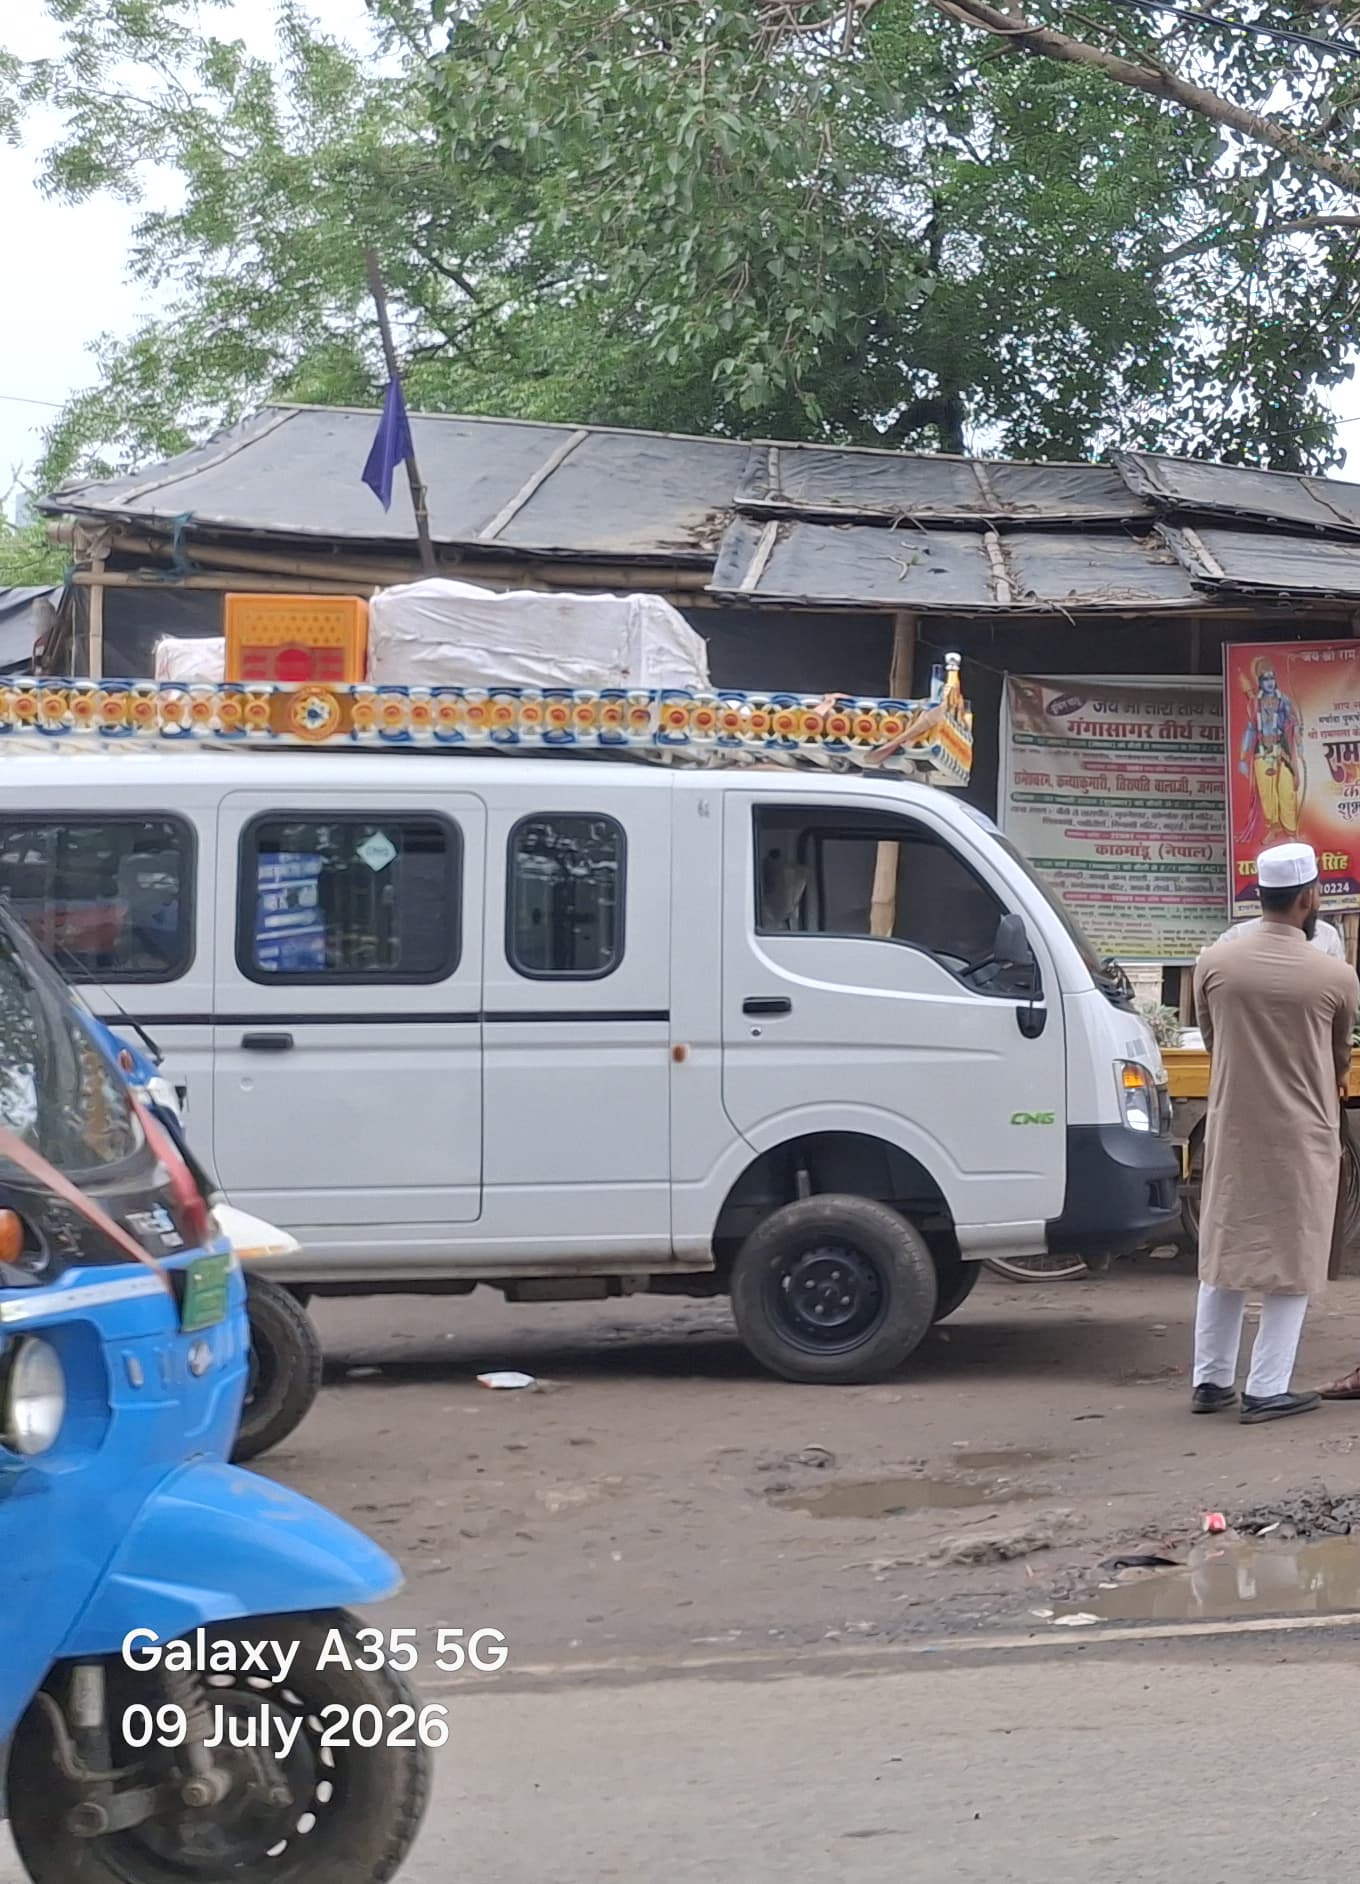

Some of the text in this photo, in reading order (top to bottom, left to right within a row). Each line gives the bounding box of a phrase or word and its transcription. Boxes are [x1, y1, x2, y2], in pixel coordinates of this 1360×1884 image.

[1067, 717, 1153, 738] गंगासागर
[1159, 719, 1193, 740] तीर्थ
[1095, 841, 1213, 861] काठमांडू (नेपाल)
[1322, 852, 1349, 872] सिंह
[1010, 1112, 1055, 1126] CNG
